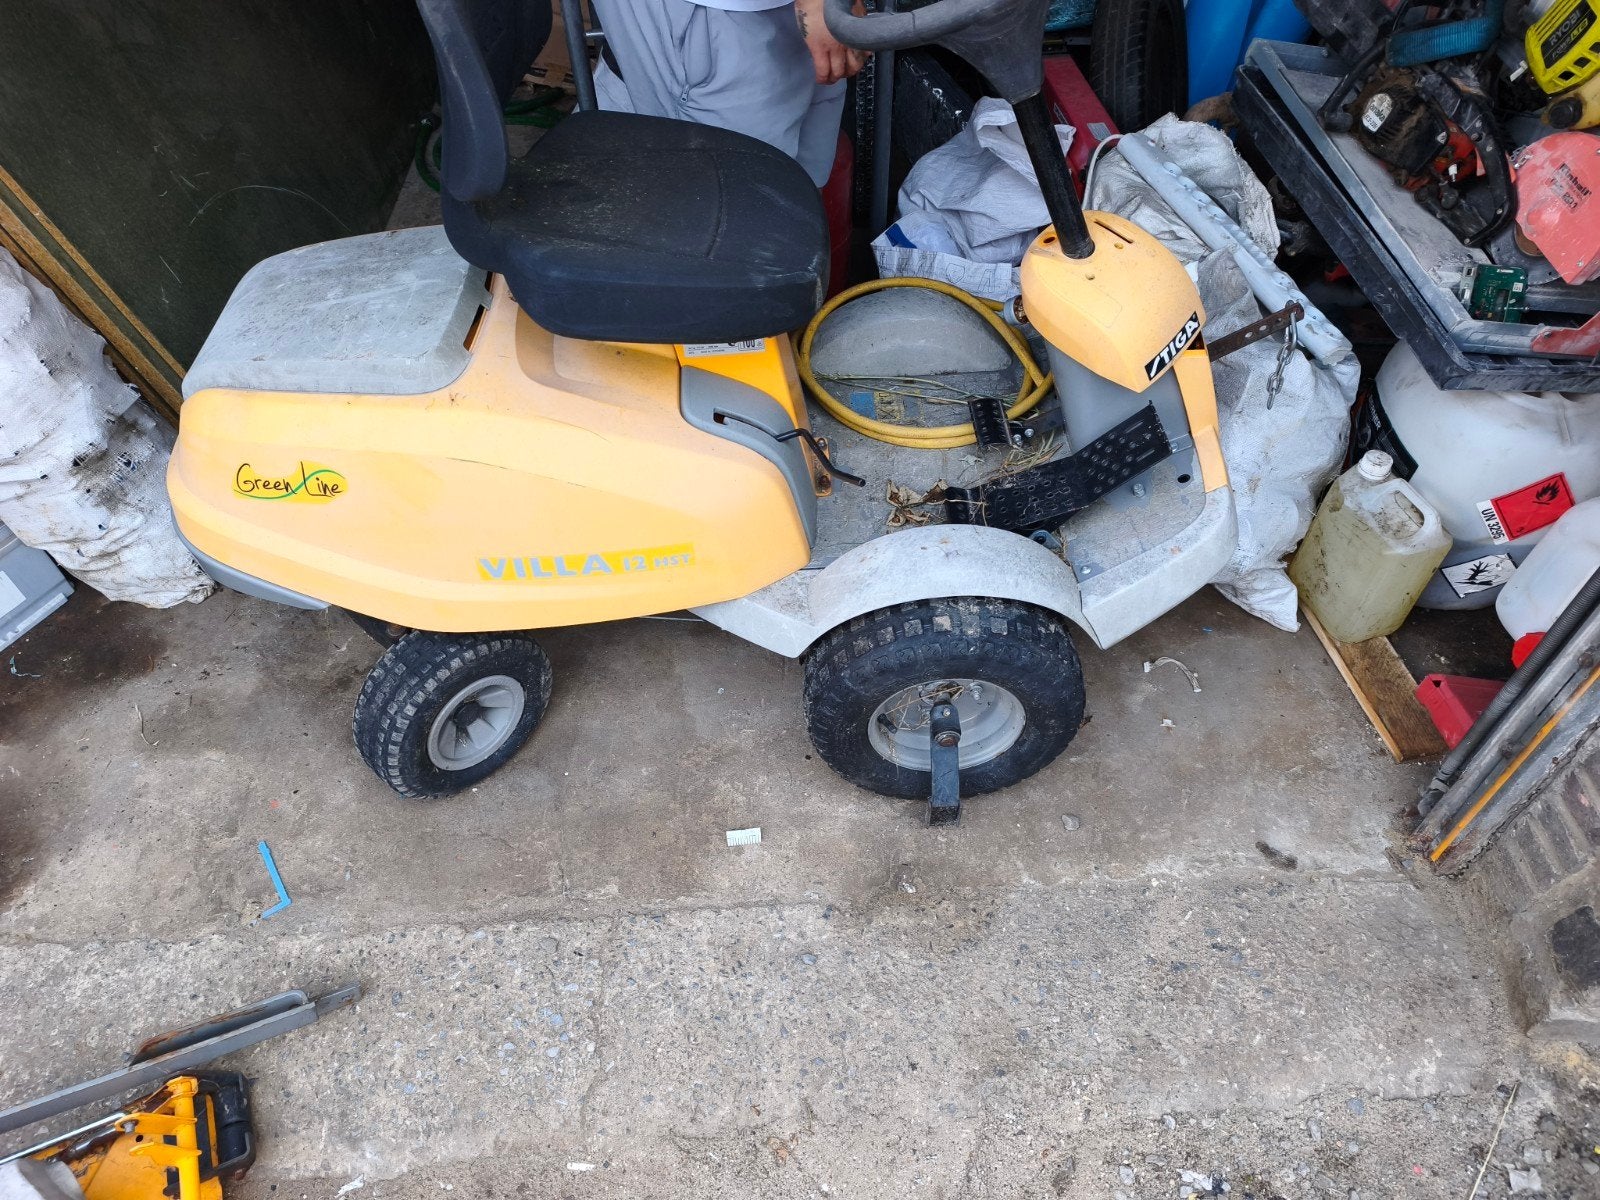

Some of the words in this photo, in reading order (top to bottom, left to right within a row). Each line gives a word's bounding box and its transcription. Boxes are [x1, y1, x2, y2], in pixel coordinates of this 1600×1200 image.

[1548, 9, 1581, 46] RYOBI
[1150, 320, 1199, 378] STIGA
[236, 463, 297, 494] Green
[300, 461, 343, 497] Line
[1481, 507, 1497, 522] UN
[1487, 521, 1505, 540] 3295
[479, 553, 613, 579] VILLA
[623, 555, 647, 572] 12
[654, 553, 691, 569] HST
